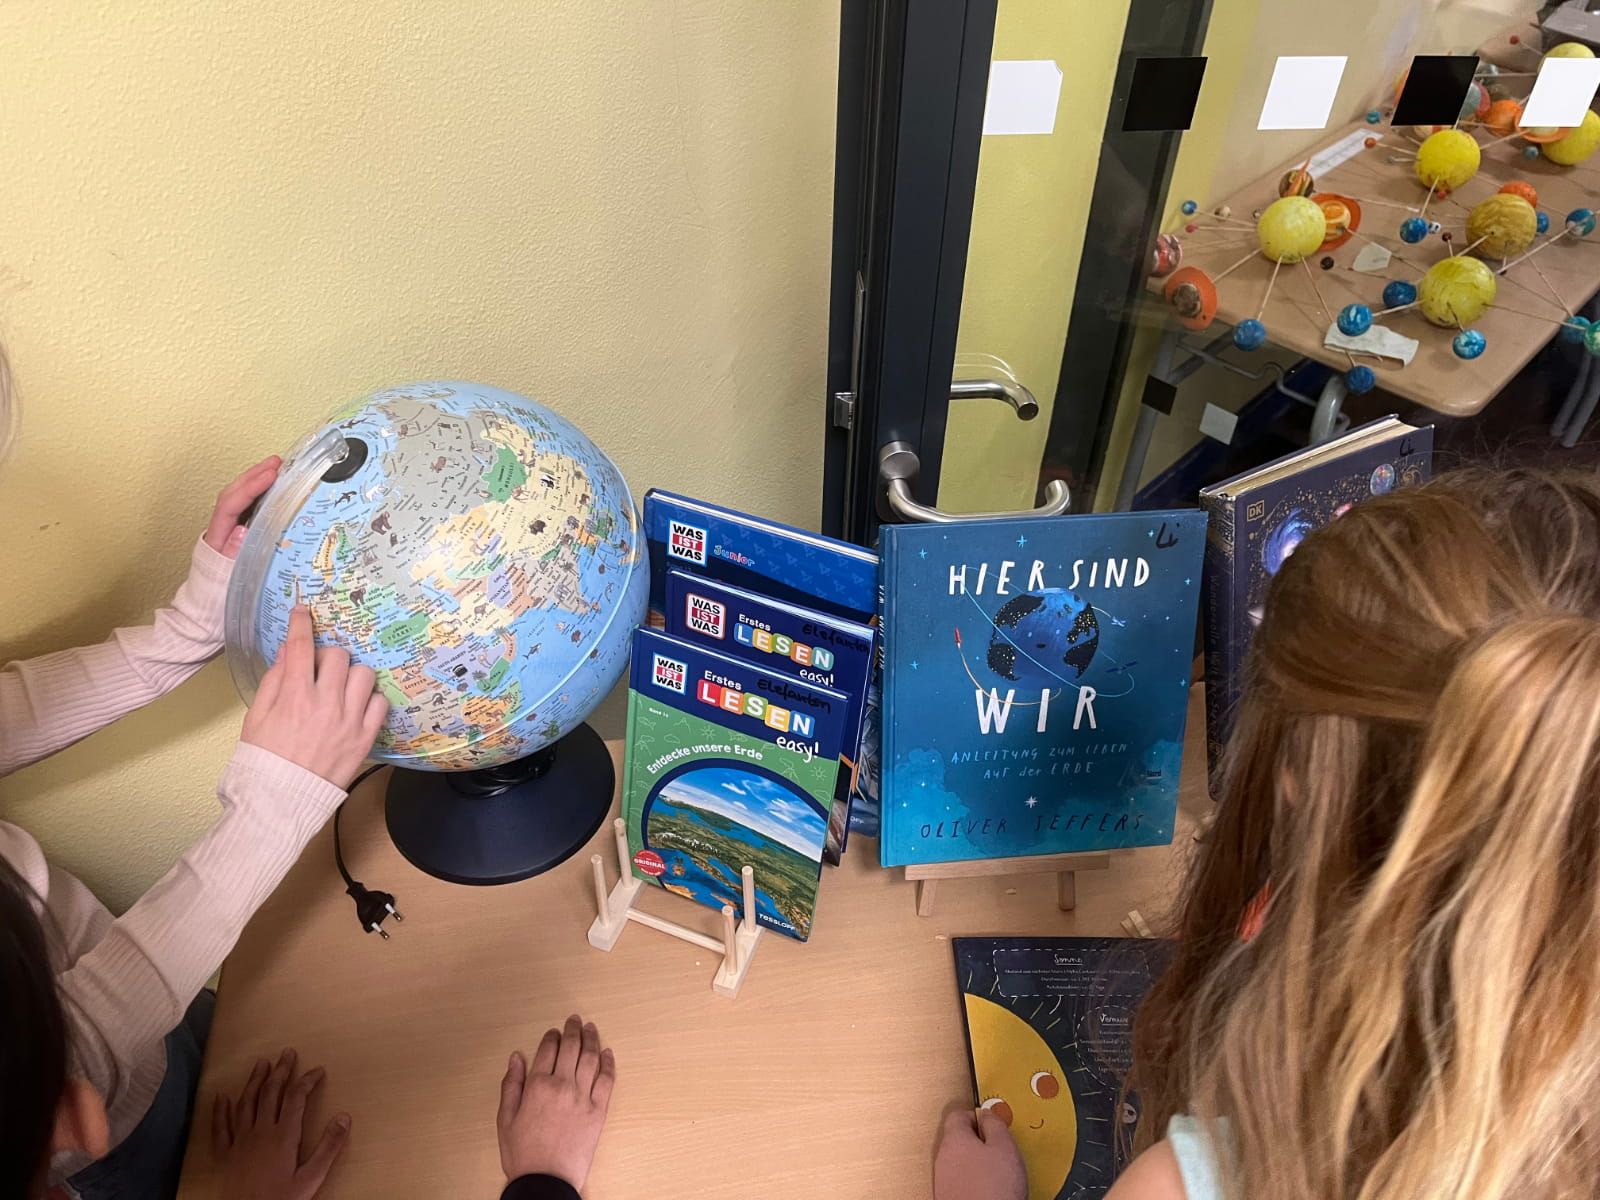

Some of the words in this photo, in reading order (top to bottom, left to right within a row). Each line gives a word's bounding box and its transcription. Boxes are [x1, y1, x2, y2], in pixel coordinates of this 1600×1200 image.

[1248, 503, 1263, 518] DK
[673, 523, 703, 540] WAS
[679, 536, 698, 549] IST
[672, 544, 702, 561] WAS
[713, 544, 755, 567] Junior
[948, 559, 1045, 595] HIER
[1068, 557, 1151, 591] SIND
[692, 597, 720, 615] WAS
[697, 610, 717, 623] IST
[738, 613, 771, 632] Erstes
[691, 617, 719, 635] WAS
[737, 624, 831, 669] LESEN
[657, 657, 683, 673] WAS
[662, 668, 679, 680] IST
[656, 674, 682, 690] WAS
[704, 669, 742, 690] Erstes
[799, 668, 834, 688] easy!
[702, 682, 811, 736] LESEN
[975, 686, 1097, 735] WIR
[776, 736, 820, 763] easy!
[951, 747, 1040, 765] ANLEITUNG
[1049, 746, 1075, 757] ZUM
[1085, 743, 1127, 755] LEBEN
[646, 748, 691, 774] Entdecke
[691, 744, 732, 754] unsere
[734, 744, 764, 761] Erde
[1018, 766, 1042, 777] der
[1050, 761, 1094, 776] ERDE
[920, 815, 1008, 839] OLIVER
[1033, 813, 1145, 833] JEFFERS
[633, 858, 666, 870] ORIGINAL
